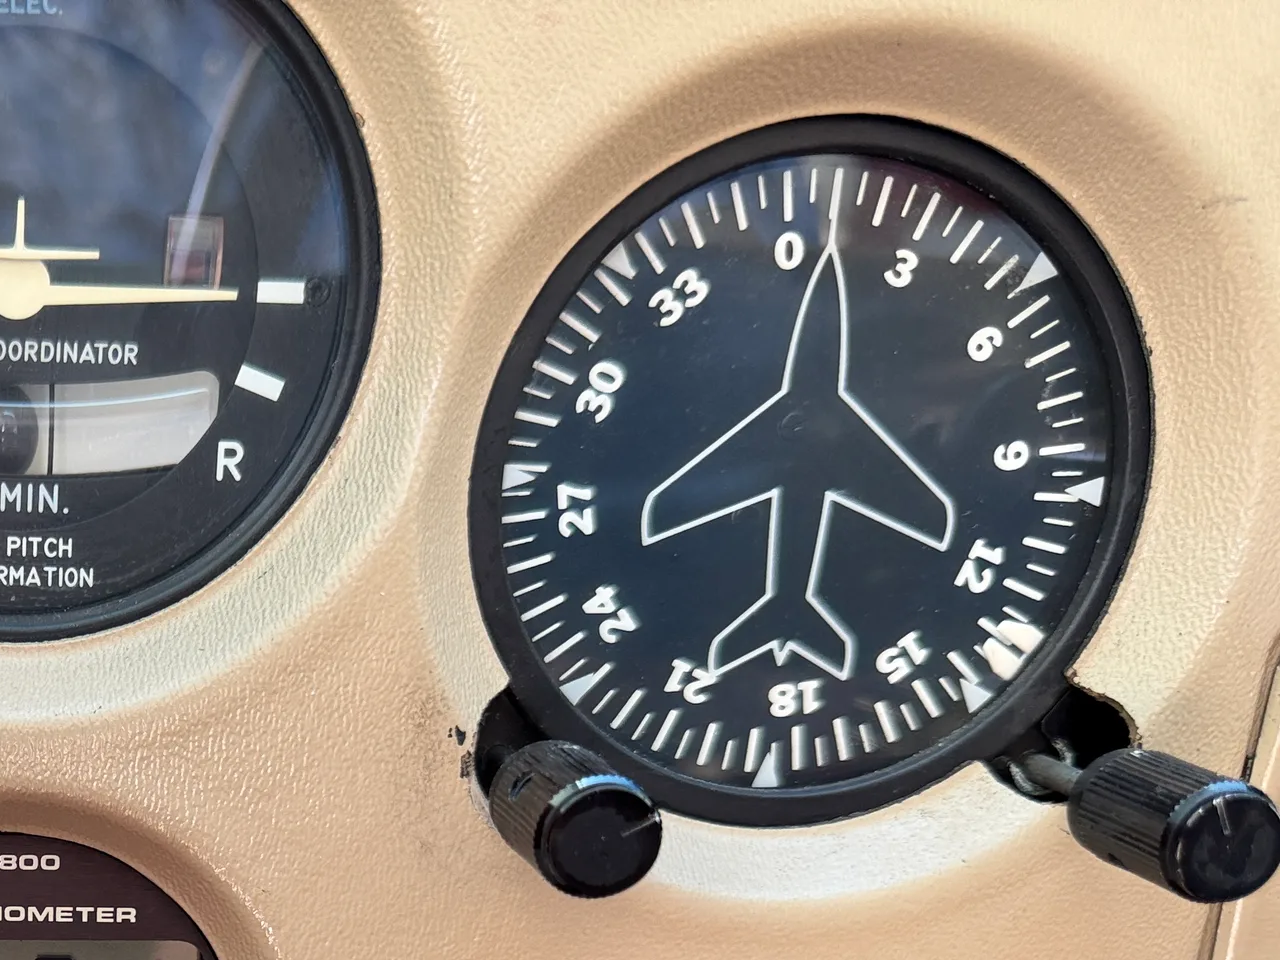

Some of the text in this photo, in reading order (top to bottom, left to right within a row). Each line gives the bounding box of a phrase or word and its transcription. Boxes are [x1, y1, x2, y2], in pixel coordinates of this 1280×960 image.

[775, 231, 804, 271] 0
[884, 248, 919, 288] 3
[647, 266, 712, 328] 33
[967, 325, 1003, 362] 6
[575, 360, 627, 424] 30
[216, 441, 245, 482] R
[993, 440, 1026, 471] 9
[0, 484, 70, 514] MIN.
[557, 483, 597, 537] 27
[6, 536, 73, 558] PITCH
[953, 537, 1008, 594] 12
[582, 583, 640, 643] 24
[874, 630, 933, 682] 15
[664, 656, 718, 706] 21
[768, 679, 827, 716] 18
